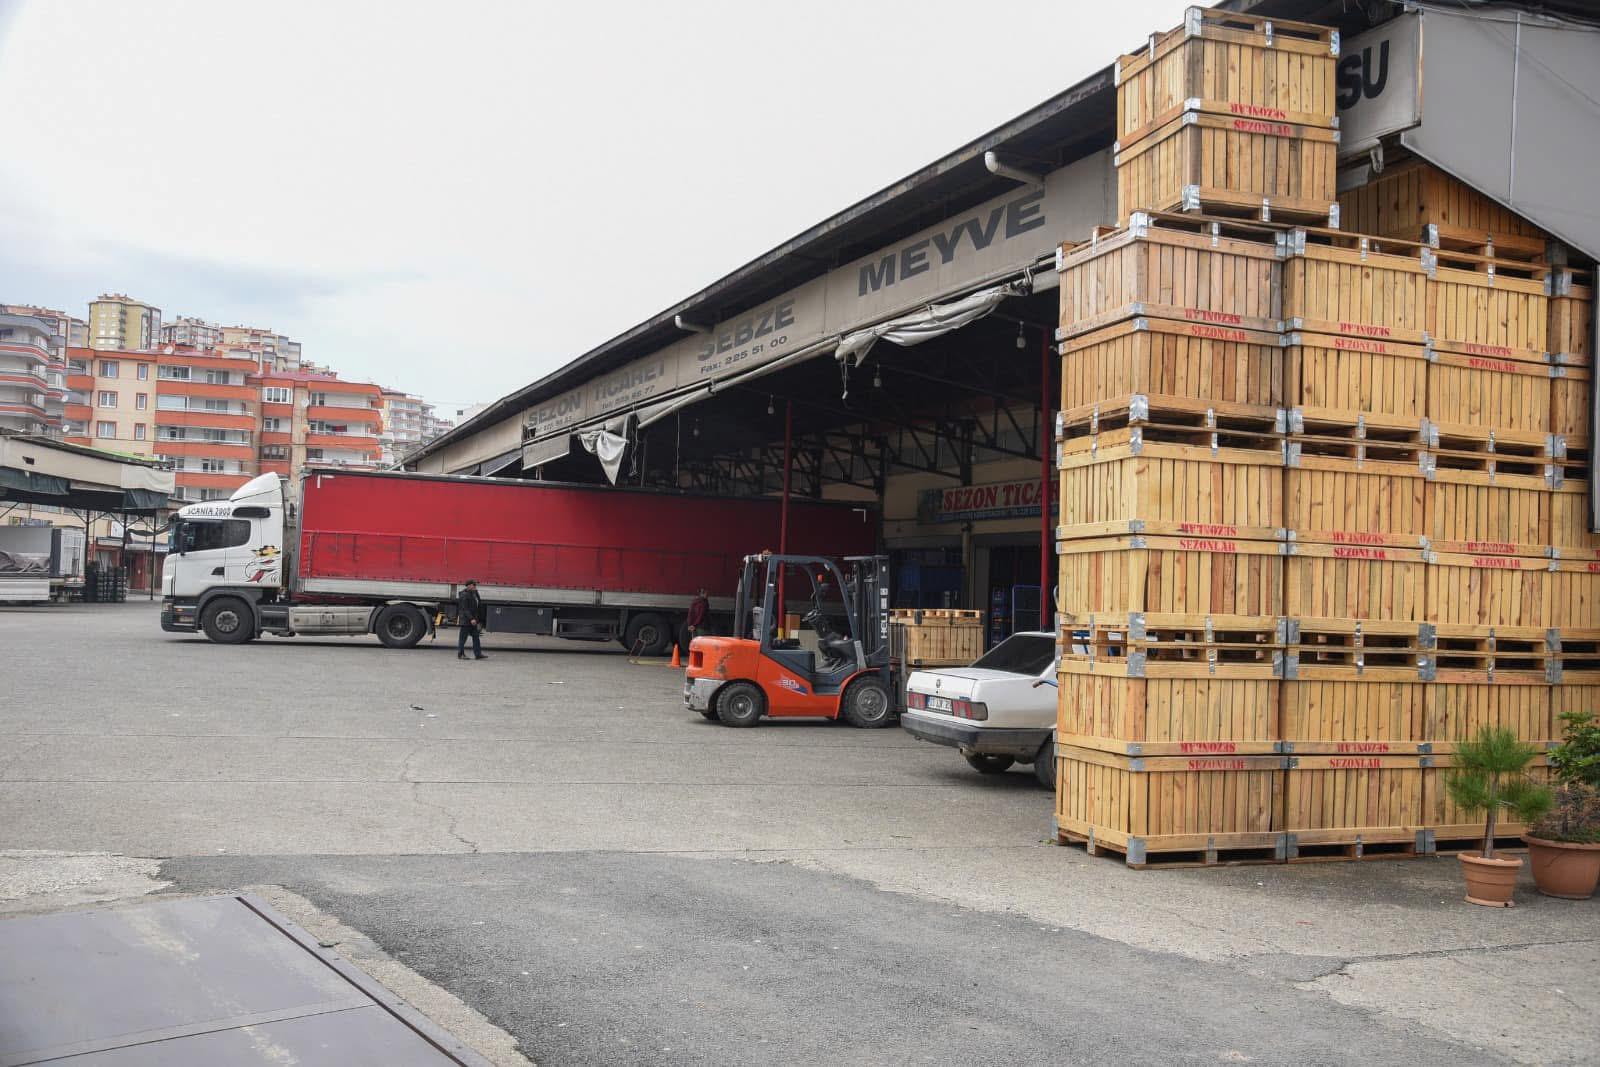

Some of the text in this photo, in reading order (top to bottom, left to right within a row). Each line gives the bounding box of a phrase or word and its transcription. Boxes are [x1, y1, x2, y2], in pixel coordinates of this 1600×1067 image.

[698, 297, 795, 361] SEBZE
[858, 190, 1046, 297] MEYVE
[770, 335, 788, 349] 00
[944, 485, 998, 512] SEZON
